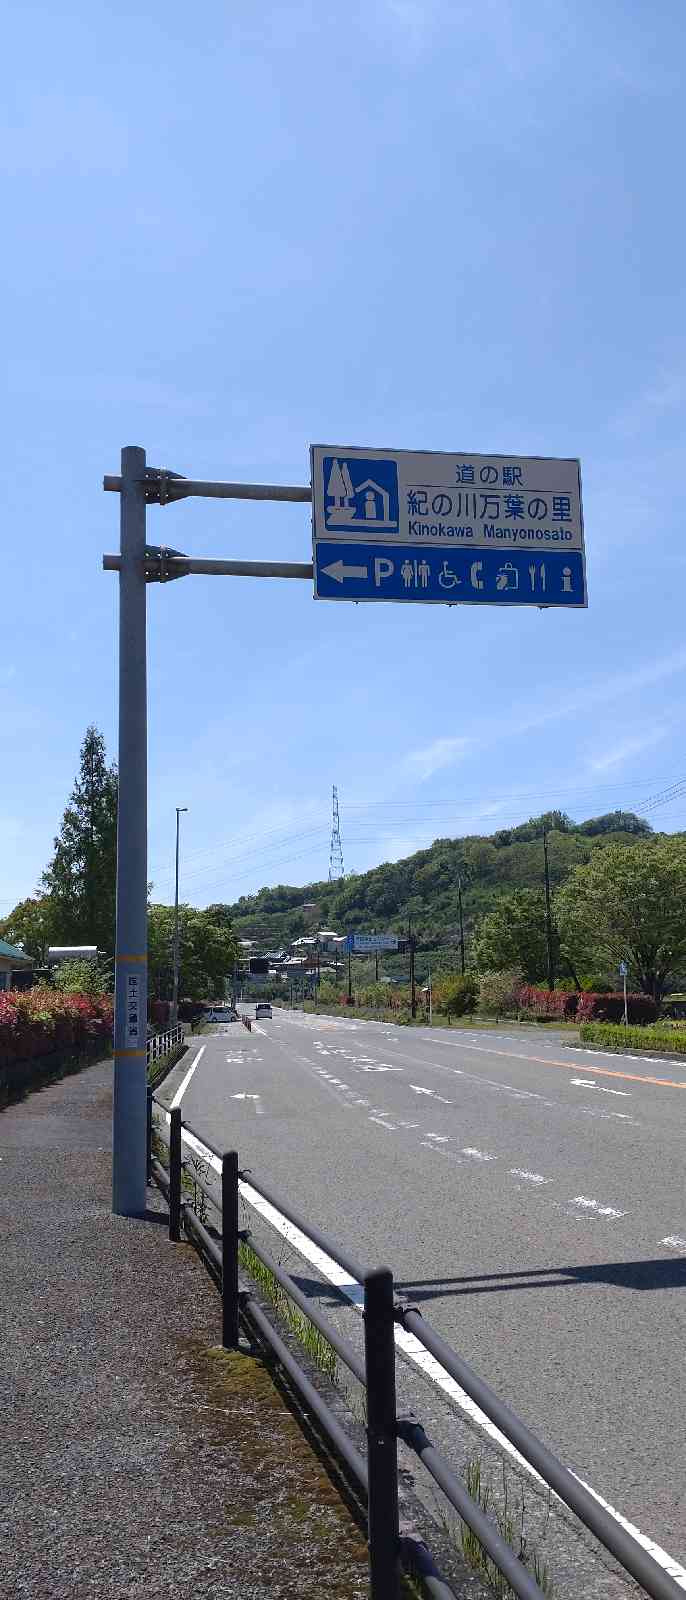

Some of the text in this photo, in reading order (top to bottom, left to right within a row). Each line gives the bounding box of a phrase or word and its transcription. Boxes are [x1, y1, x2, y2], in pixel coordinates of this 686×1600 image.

[455, 464, 523, 487] 道の駅
[407, 490, 572, 522] 紀の川万葉の里
[407, 520, 573, 543] Kinokawa Manyonosato
[374, 558, 395, 588] P
